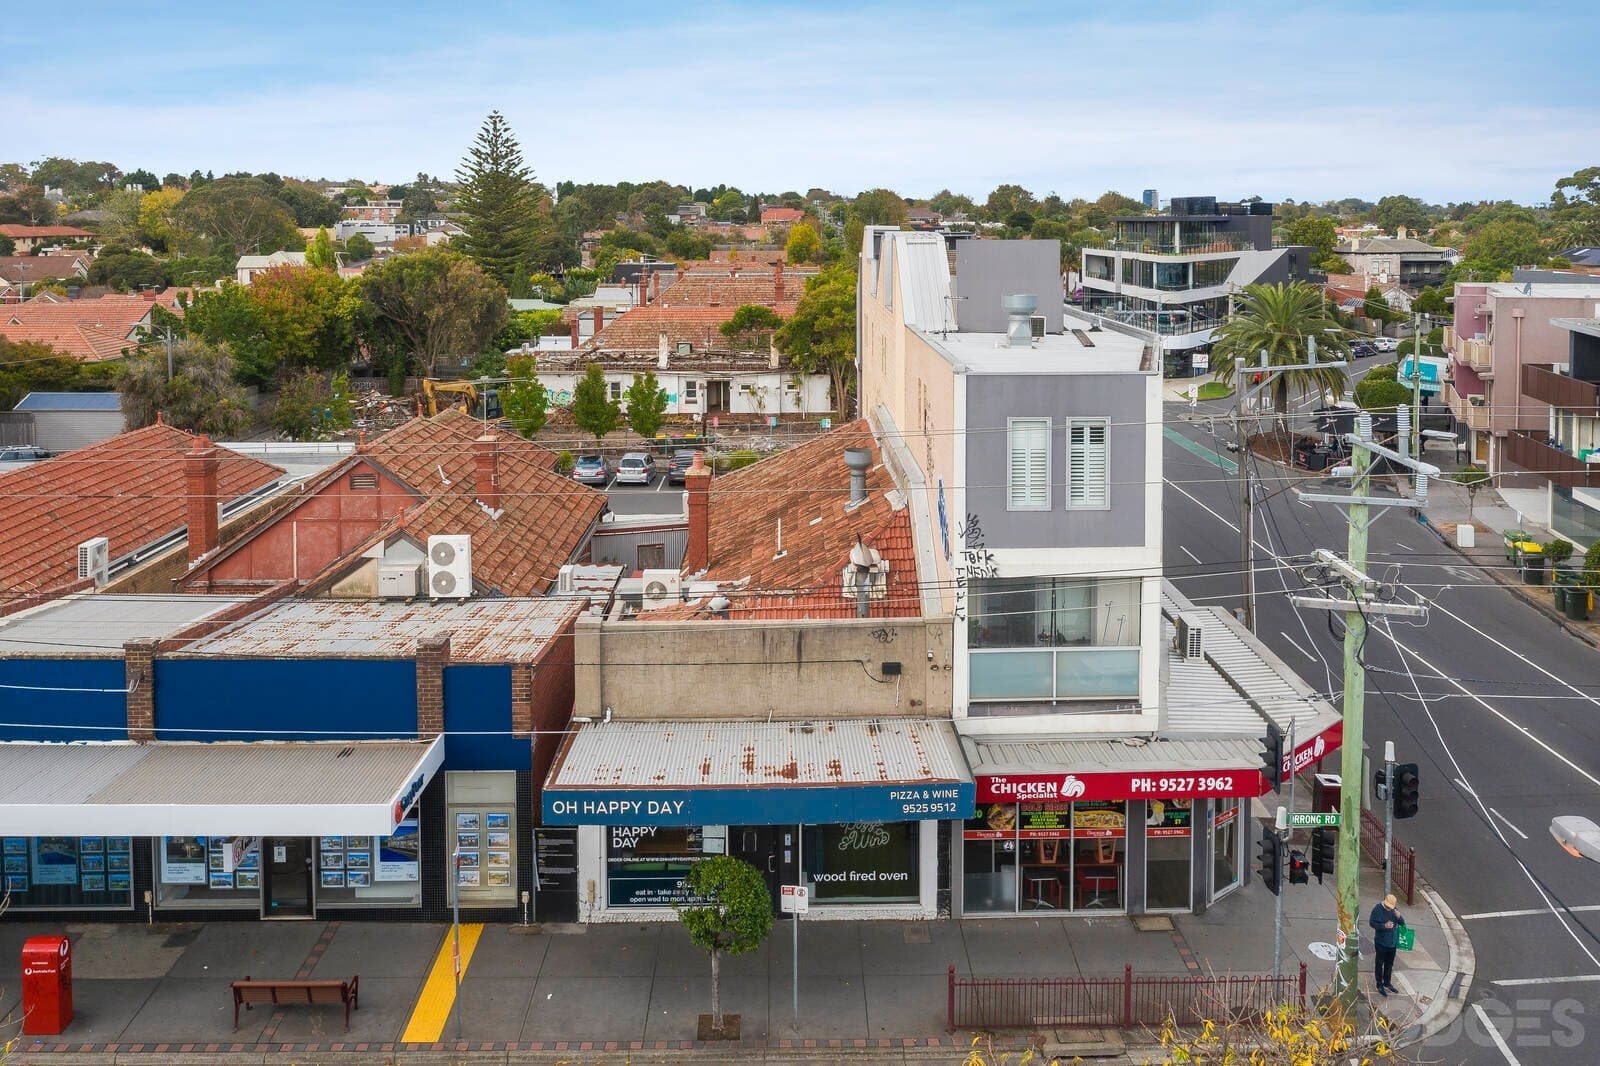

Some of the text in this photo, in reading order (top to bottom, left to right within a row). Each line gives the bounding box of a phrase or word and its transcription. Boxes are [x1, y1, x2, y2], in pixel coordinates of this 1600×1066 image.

[1283, 746, 1313, 772] CHCKEN
[990, 783, 1057, 794] CHICKEN
[1131, 777, 1233, 792] PH: 9527 3962
[890, 789, 959, 800] PIZZA & WINE
[1016, 792, 1058, 800] Specialist
[552, 801, 684, 814] OH HAPPY DAY
[902, 803, 956, 814] 9525 9512
[1325, 815, 1336, 823] RD
[612, 827, 657, 837] HAPPY
[612, 838, 639, 848] DAY
[813, 870, 908, 882] wood fired oven
